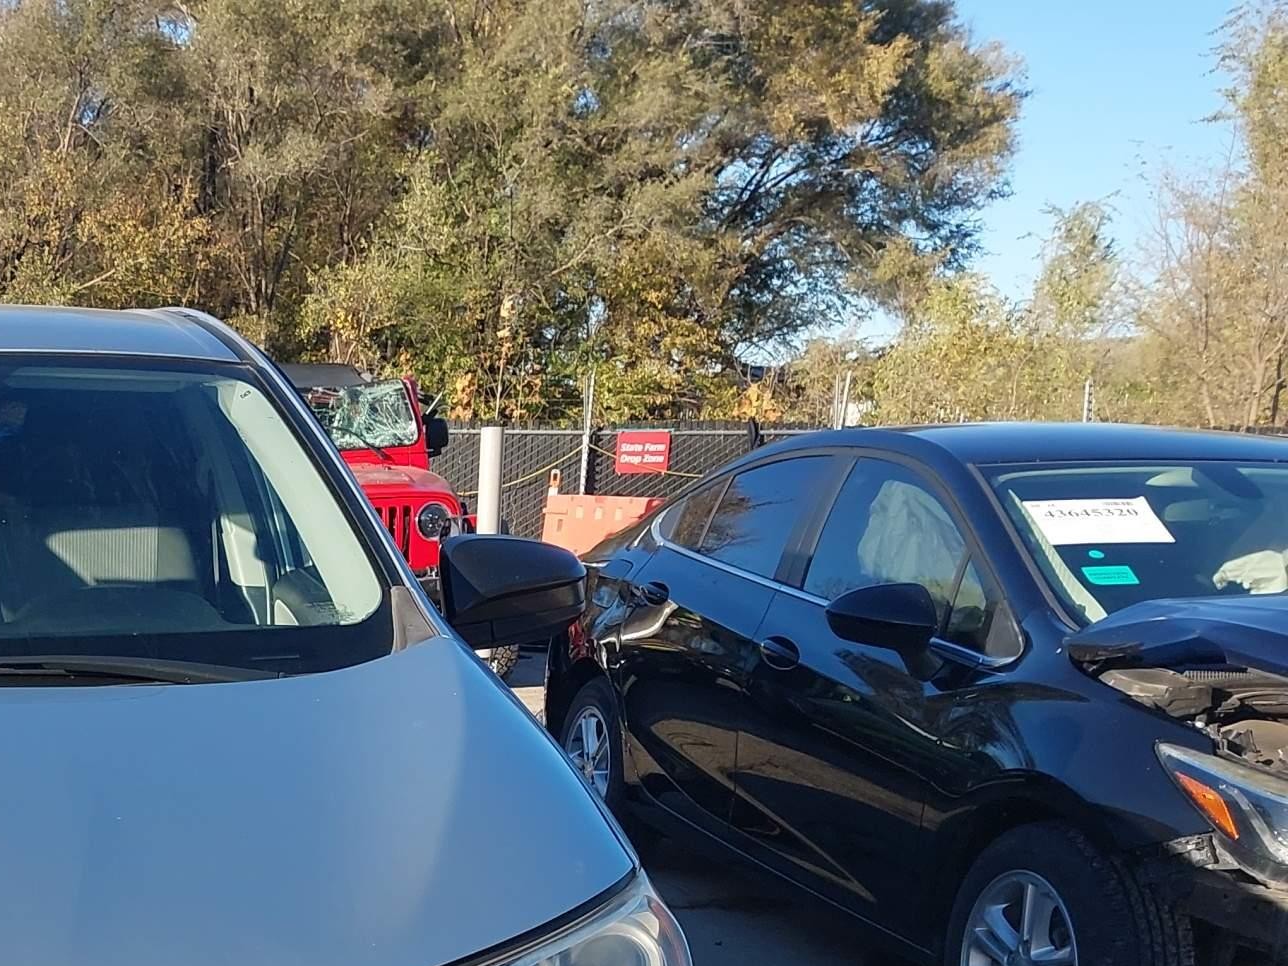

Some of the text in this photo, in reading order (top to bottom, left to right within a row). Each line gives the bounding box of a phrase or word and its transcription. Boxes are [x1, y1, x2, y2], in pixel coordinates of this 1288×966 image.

[620, 442, 666, 452] State Farm
[619, 454, 665, 465] Drop Zone
[1044, 508, 1139, 519] 43645320
